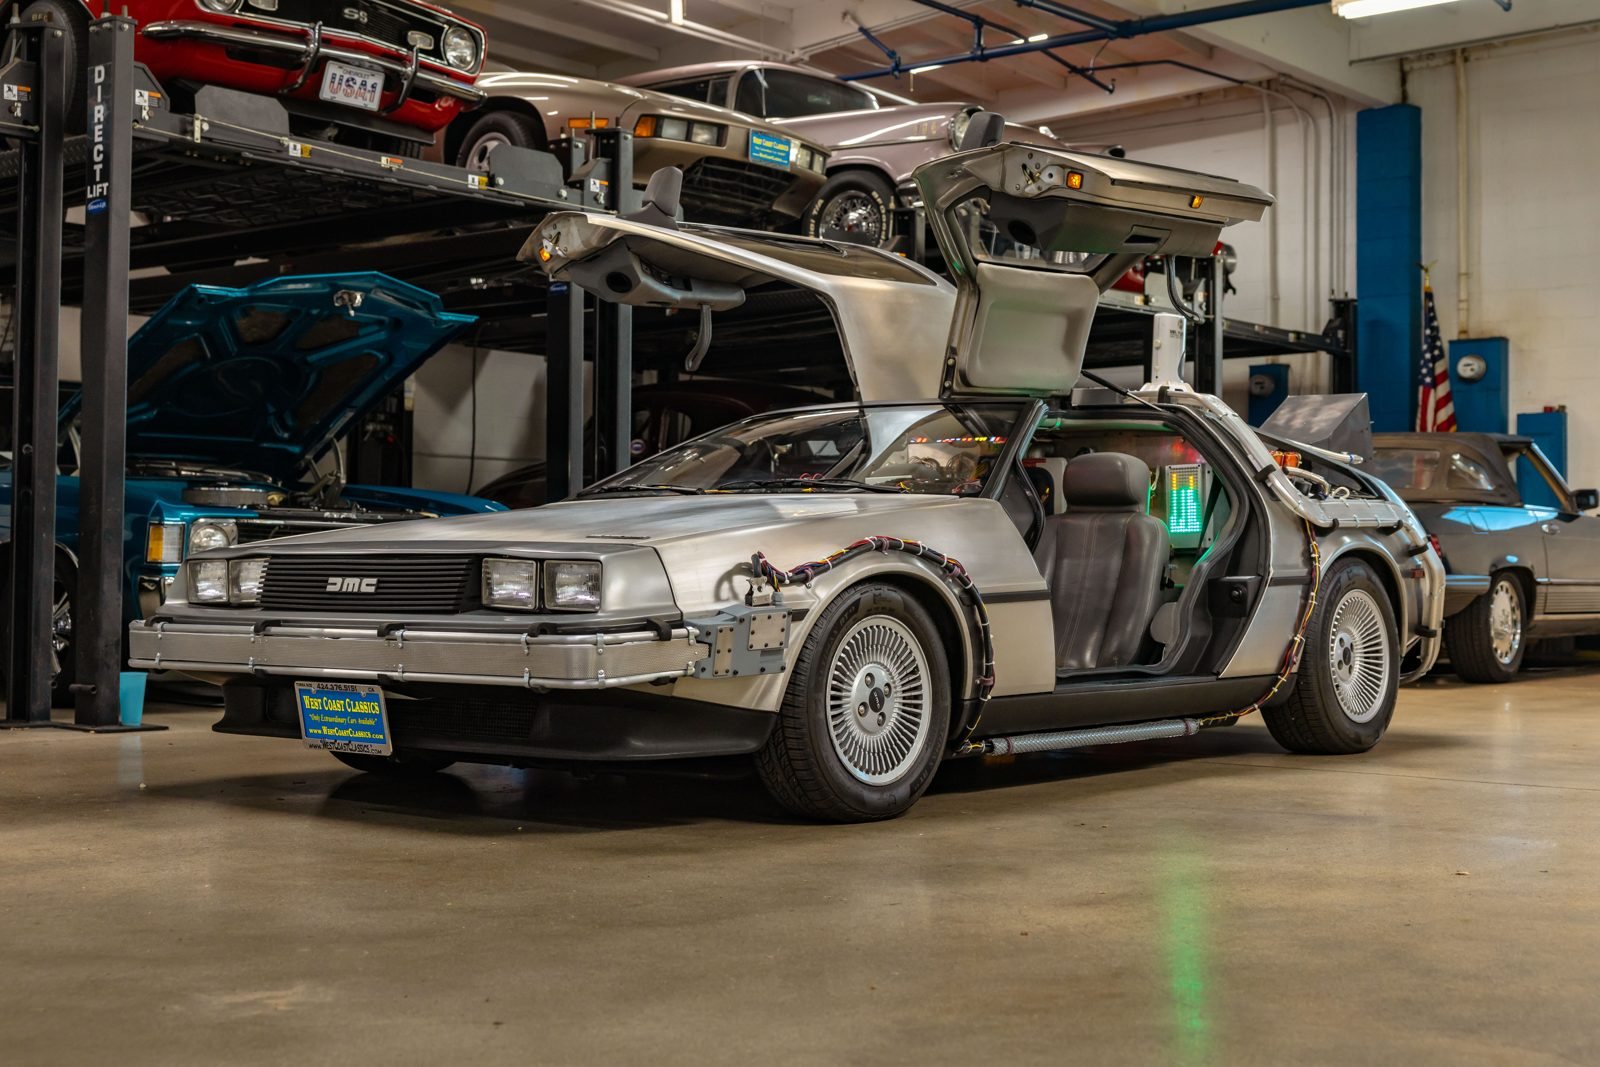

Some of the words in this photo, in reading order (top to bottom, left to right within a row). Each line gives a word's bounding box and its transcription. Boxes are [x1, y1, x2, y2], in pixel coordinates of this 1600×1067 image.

[343, 8, 368, 24] SS
[93, 65, 105, 182] DIRECT
[87, 182, 109, 198] LIFT
[326, 577, 378, 593] DMC
[303, 695, 322, 709] WEST
[323, 697, 345, 711] COAST
[345, 698, 380, 714] CLASSICS
